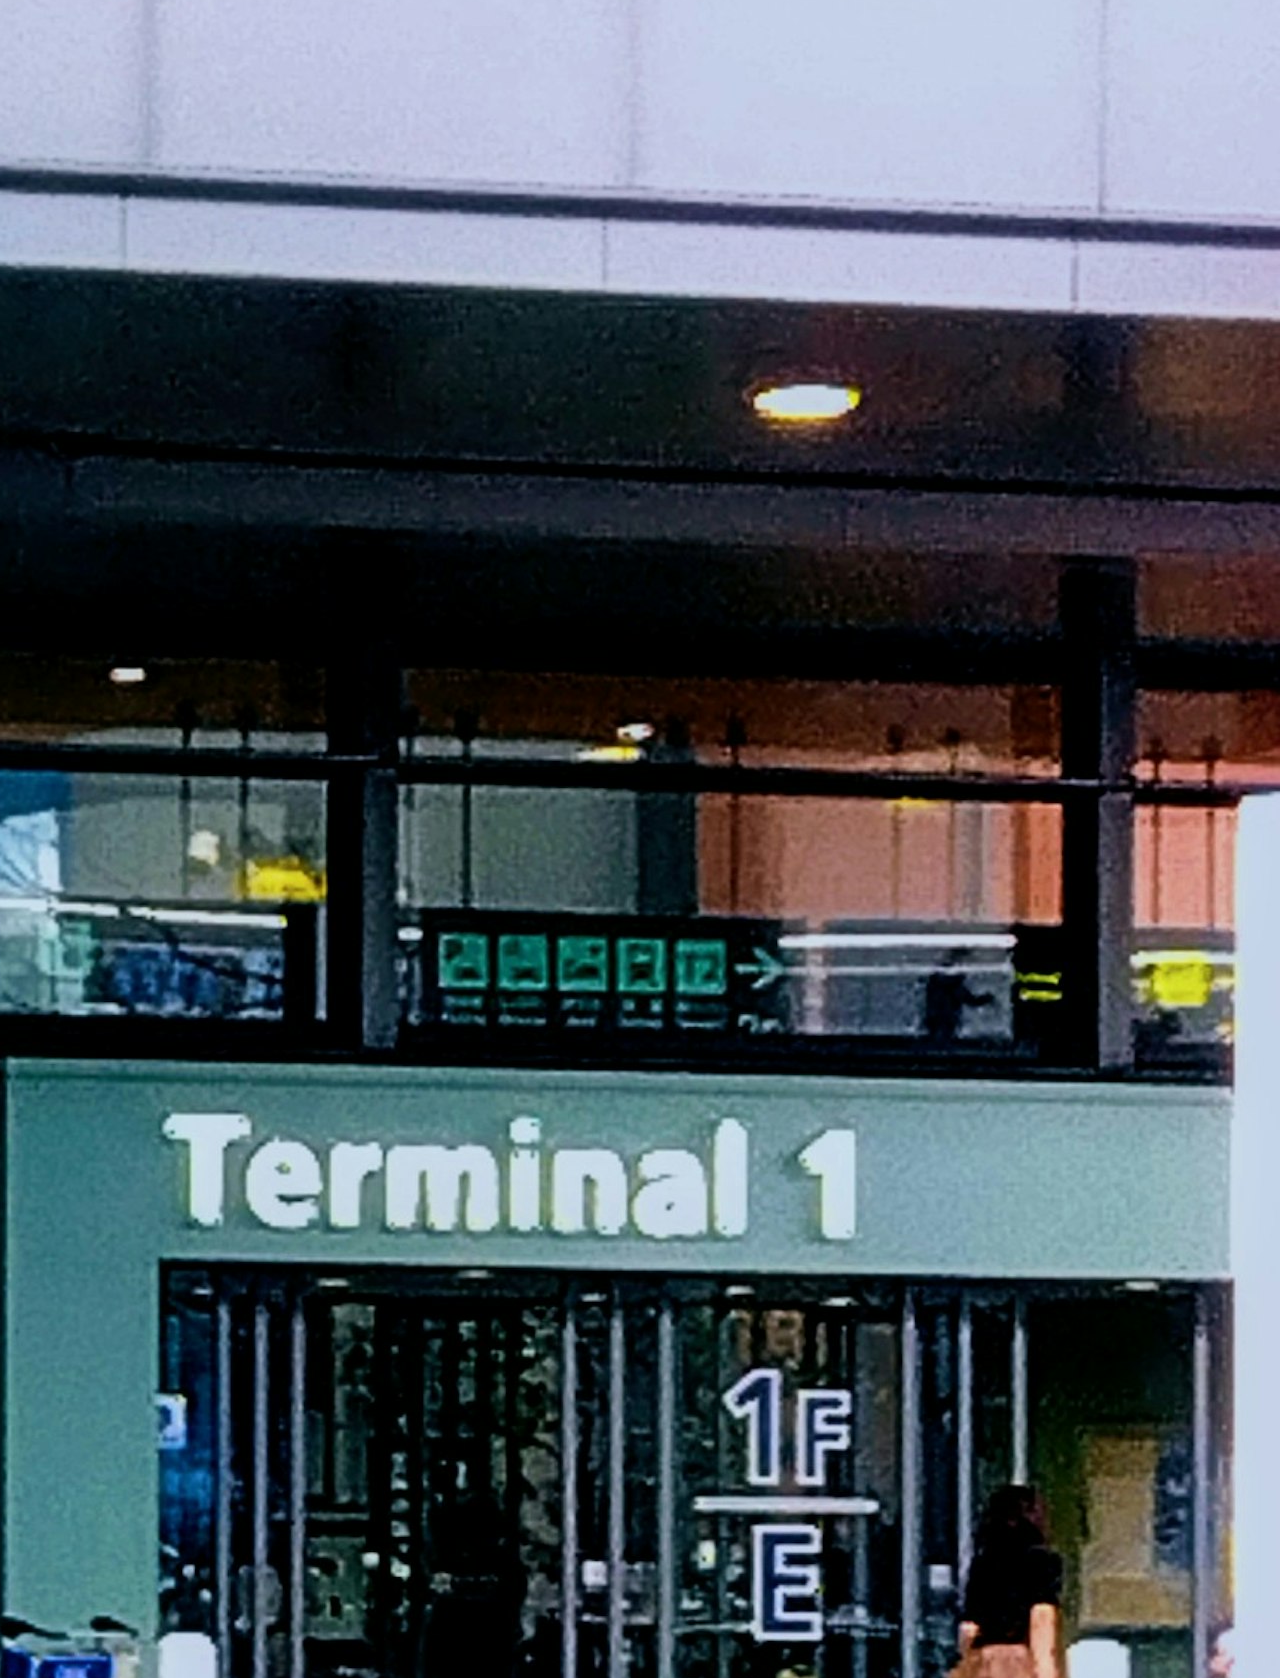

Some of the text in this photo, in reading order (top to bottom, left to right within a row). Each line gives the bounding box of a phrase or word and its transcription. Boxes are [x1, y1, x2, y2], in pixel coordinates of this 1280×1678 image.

[163, 1113, 856, 1240] Terminal 1
[722, 1368, 852, 1486] 1F
[751, 1524, 824, 1642] E
